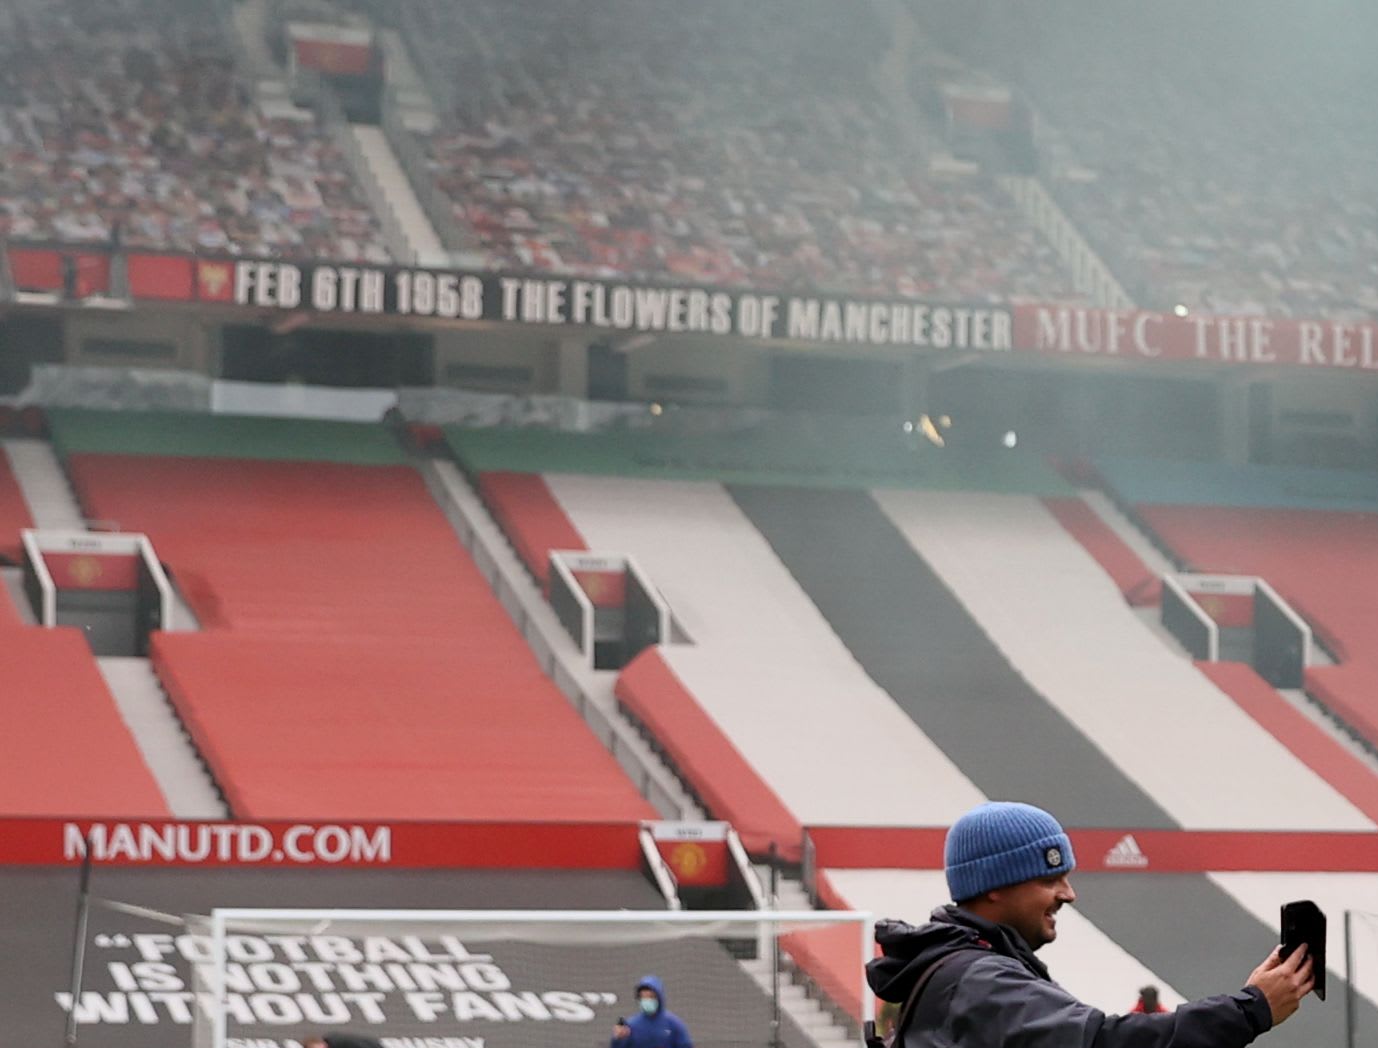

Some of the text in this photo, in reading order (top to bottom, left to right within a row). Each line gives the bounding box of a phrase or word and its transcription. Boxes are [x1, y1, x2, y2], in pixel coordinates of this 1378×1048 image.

[235, 262, 1012, 351] FEB 6TH 1958 THE FLOWERS OF MANCHESTER
[1036, 308, 1164, 358] MUFC
[1190, 316, 1276, 363] THE
[63, 823, 392, 862] MANUTD.COM
[108, 961, 511, 992] IS NOTHING
[54, 991, 387, 1024] WITHOUT
